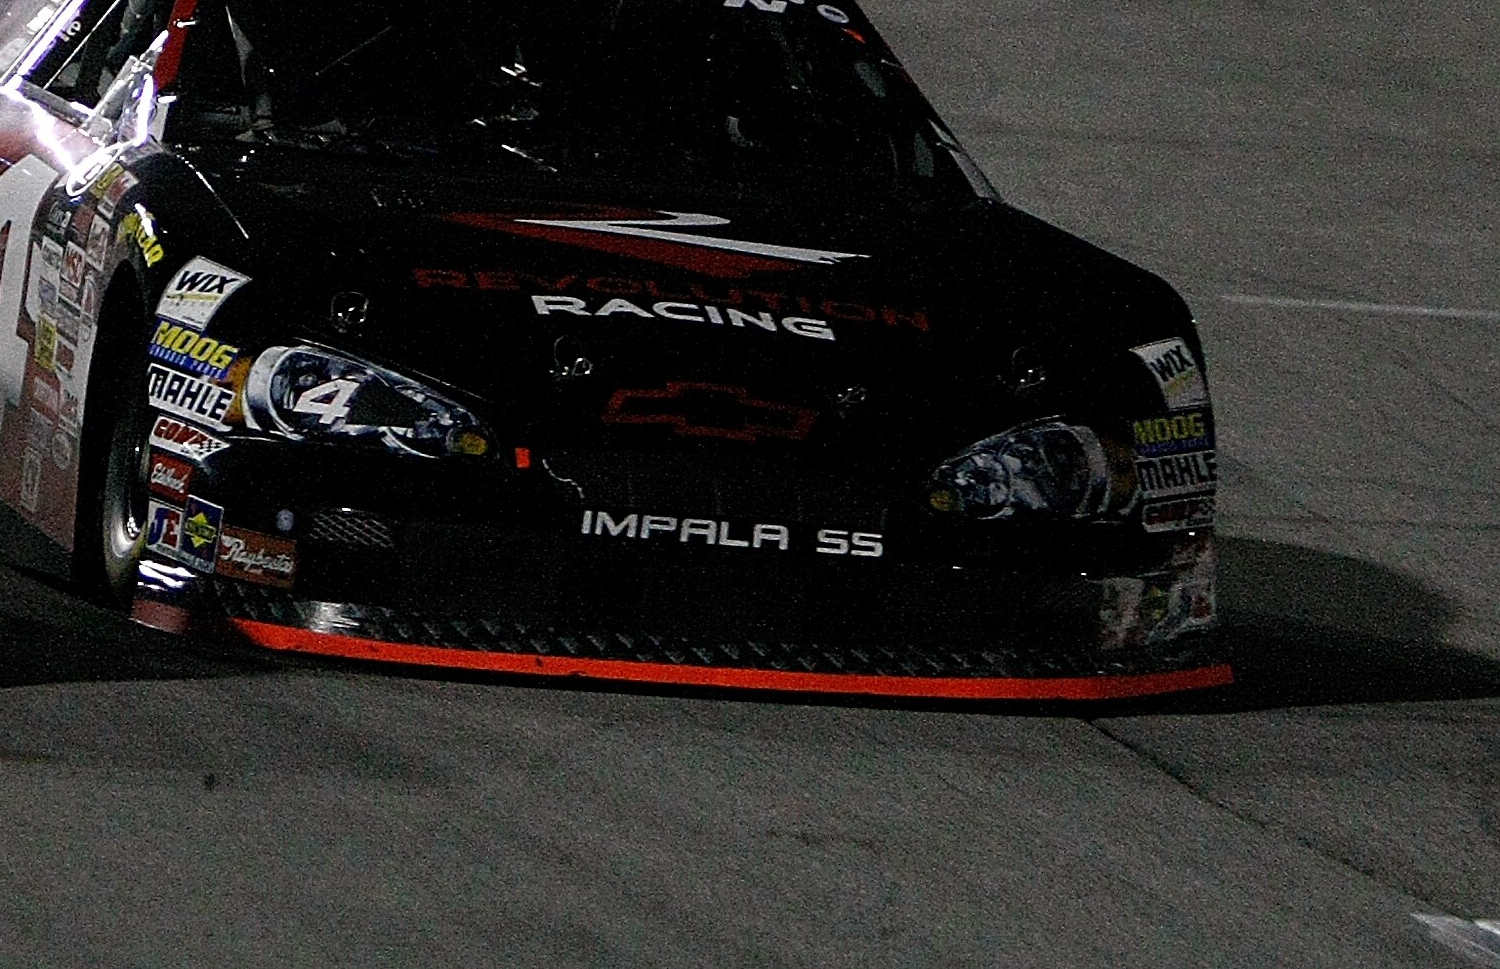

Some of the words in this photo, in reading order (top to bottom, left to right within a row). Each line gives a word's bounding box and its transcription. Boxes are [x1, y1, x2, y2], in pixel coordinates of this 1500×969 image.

[176, 270, 239, 294] WIX
[414, 267, 929, 331] REVOLUTION
[531, 294, 836, 342] RACING
[150, 320, 240, 370] MOOG
[1149, 345, 1194, 382] WIX
[149, 368, 233, 423] MAHLE
[291, 377, 361, 426] 4
[1133, 412, 1205, 445] MOOG
[1136, 452, 1217, 492] MAHLE
[580, 509, 789, 552] IMPALA
[815, 528, 884, 558] SS
